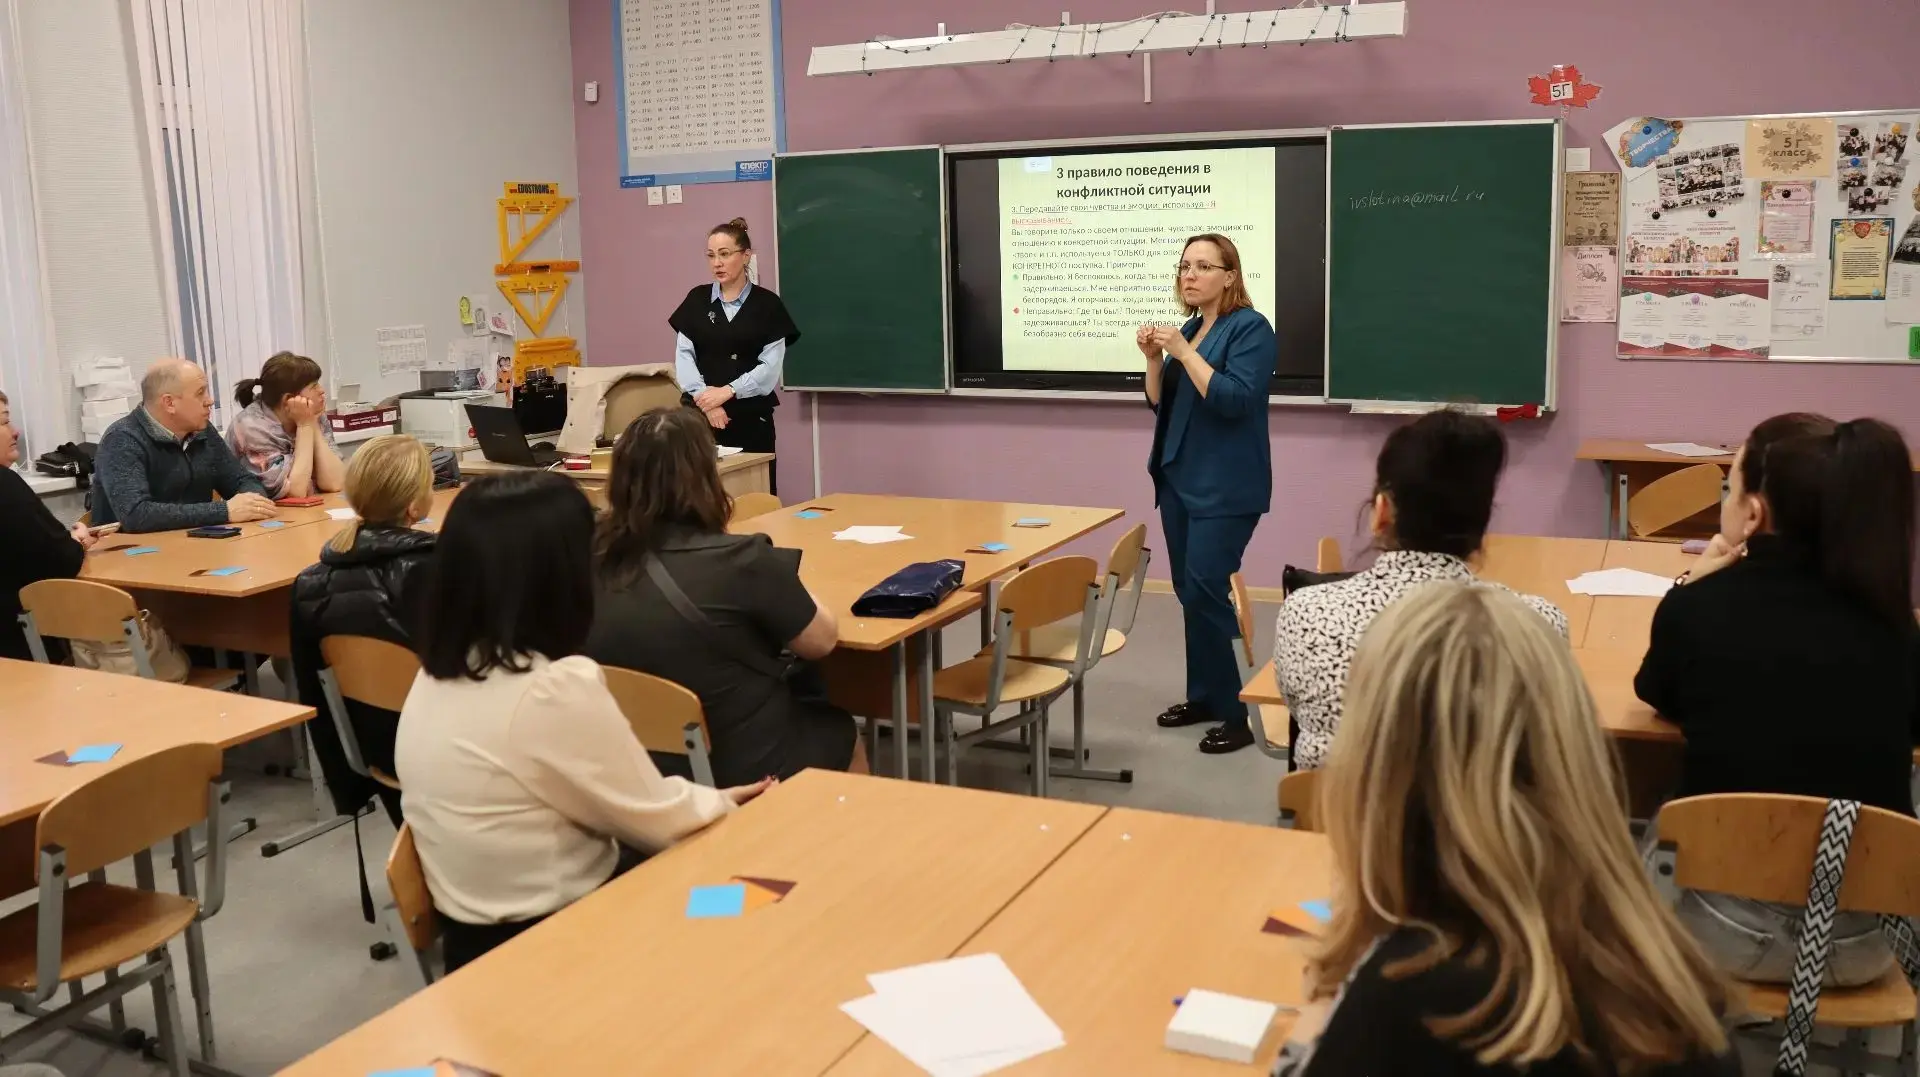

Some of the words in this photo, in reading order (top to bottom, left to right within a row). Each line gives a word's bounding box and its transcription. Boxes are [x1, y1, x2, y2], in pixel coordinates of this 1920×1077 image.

[1552, 84, 1571, 98] 5Г
[1629, 127, 1674, 157] ТВОРЧЕСТВА
[1784, 138, 1792, 148] 5
[1773, 149, 1807, 157] класс
[1056, 167, 1064, 179] 3
[1067, 168, 1123, 180] правило
[1126, 164, 1200, 178] поведения
[1203, 164, 1211, 174] в
[1056, 184, 1145, 199] конфликтной
[1148, 184, 1211, 197] ситуации
[1125, 307, 1155, 315] Почему
